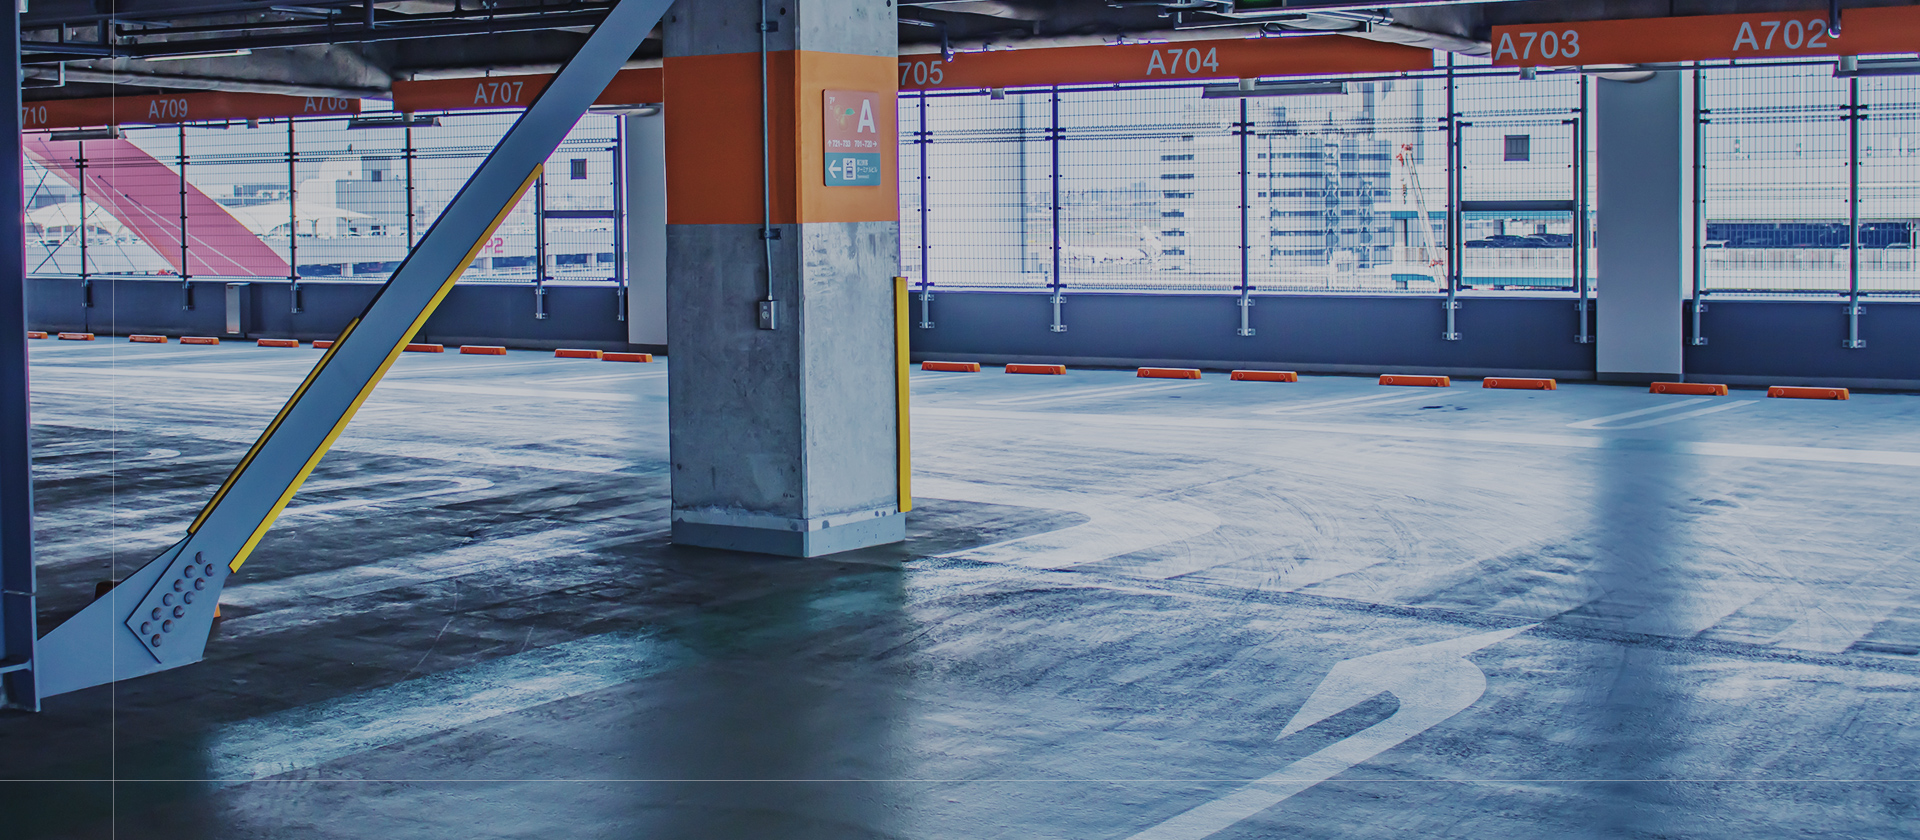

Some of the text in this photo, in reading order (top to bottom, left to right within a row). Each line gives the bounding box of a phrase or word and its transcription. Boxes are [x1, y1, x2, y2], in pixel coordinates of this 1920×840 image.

[1494, 30, 1580, 60] A703
[1733, 19, 1827, 50] A702
[898, 61, 944, 86] 705
[1146, 47, 1219, 75] A704
[474, 82, 524, 104] A707
[149, 99, 188, 118] A709
[857, 99, 876, 133] A
